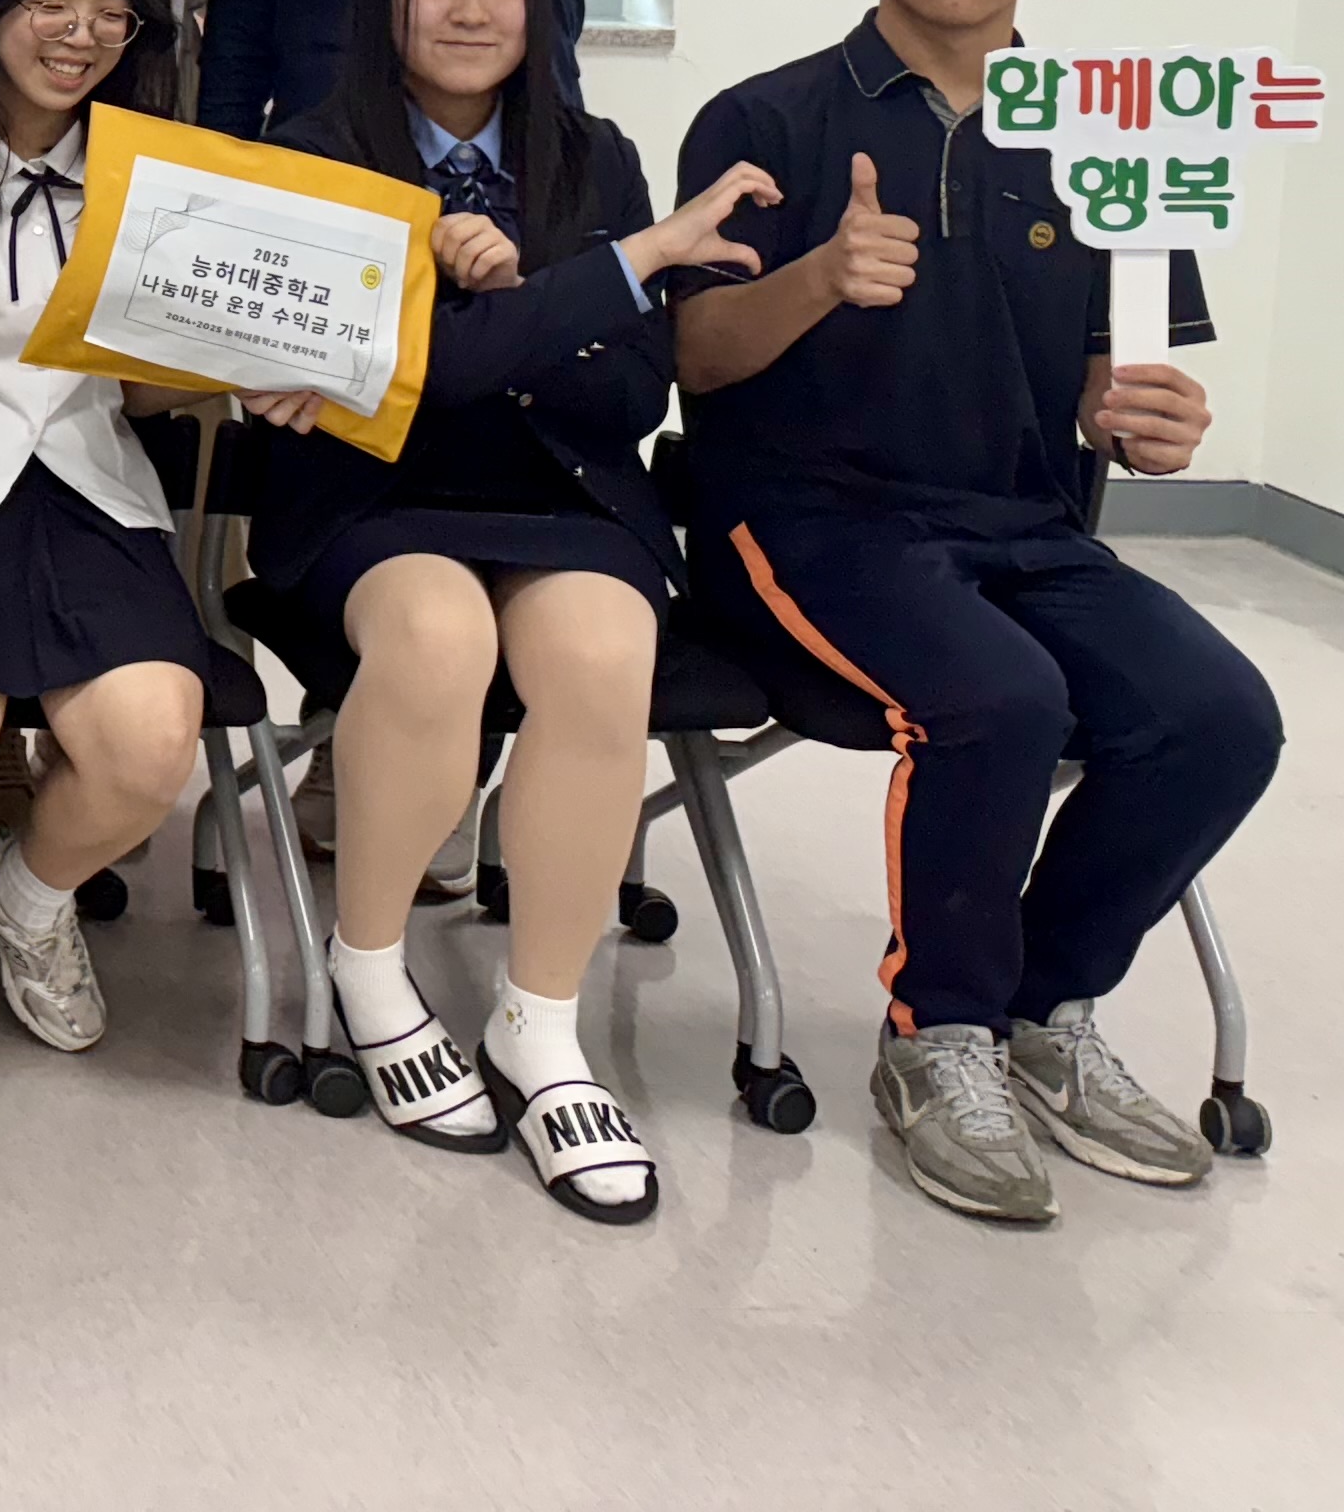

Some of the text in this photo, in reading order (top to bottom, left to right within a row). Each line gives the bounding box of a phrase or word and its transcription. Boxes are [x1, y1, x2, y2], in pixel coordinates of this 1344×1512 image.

[986, 55, 1325, 131] 함께하는
[1069, 156, 1235, 232] 행복
[191, 255, 331, 306] 능허대중학교
[252, 248, 290, 268] 2025
[142, 274, 371, 345] 나눔마당 운영 수익금 기부
[377, 1036, 472, 1106] NIKE
